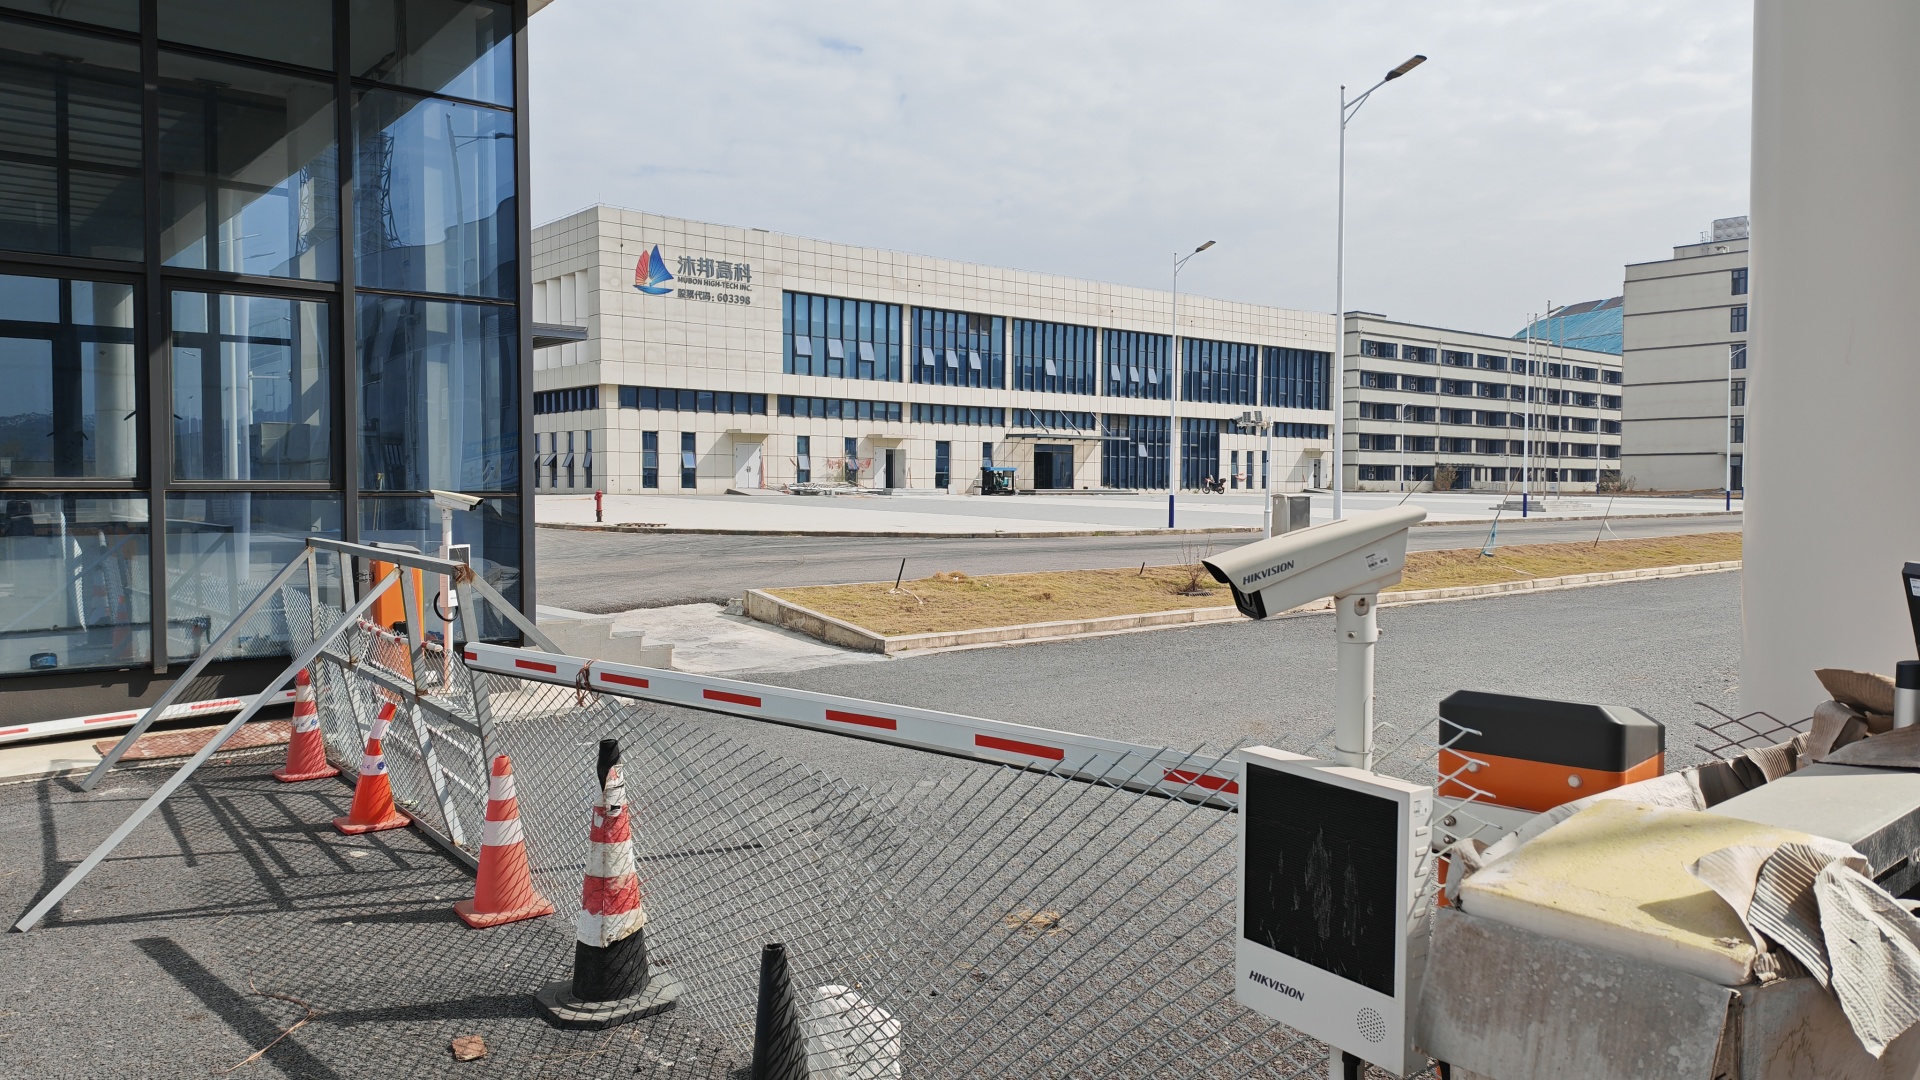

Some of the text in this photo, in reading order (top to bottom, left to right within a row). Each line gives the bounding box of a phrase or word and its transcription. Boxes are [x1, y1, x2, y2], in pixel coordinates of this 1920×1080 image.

[677, 255, 752, 283] 沐邦高科
[677, 276, 752, 292] MUBON HIGH-TECH INC.
[717, 292, 751, 305] 603398
[1243, 560, 1294, 585] HIKVISION
[1249, 970, 1305, 1002] HIKVISION
